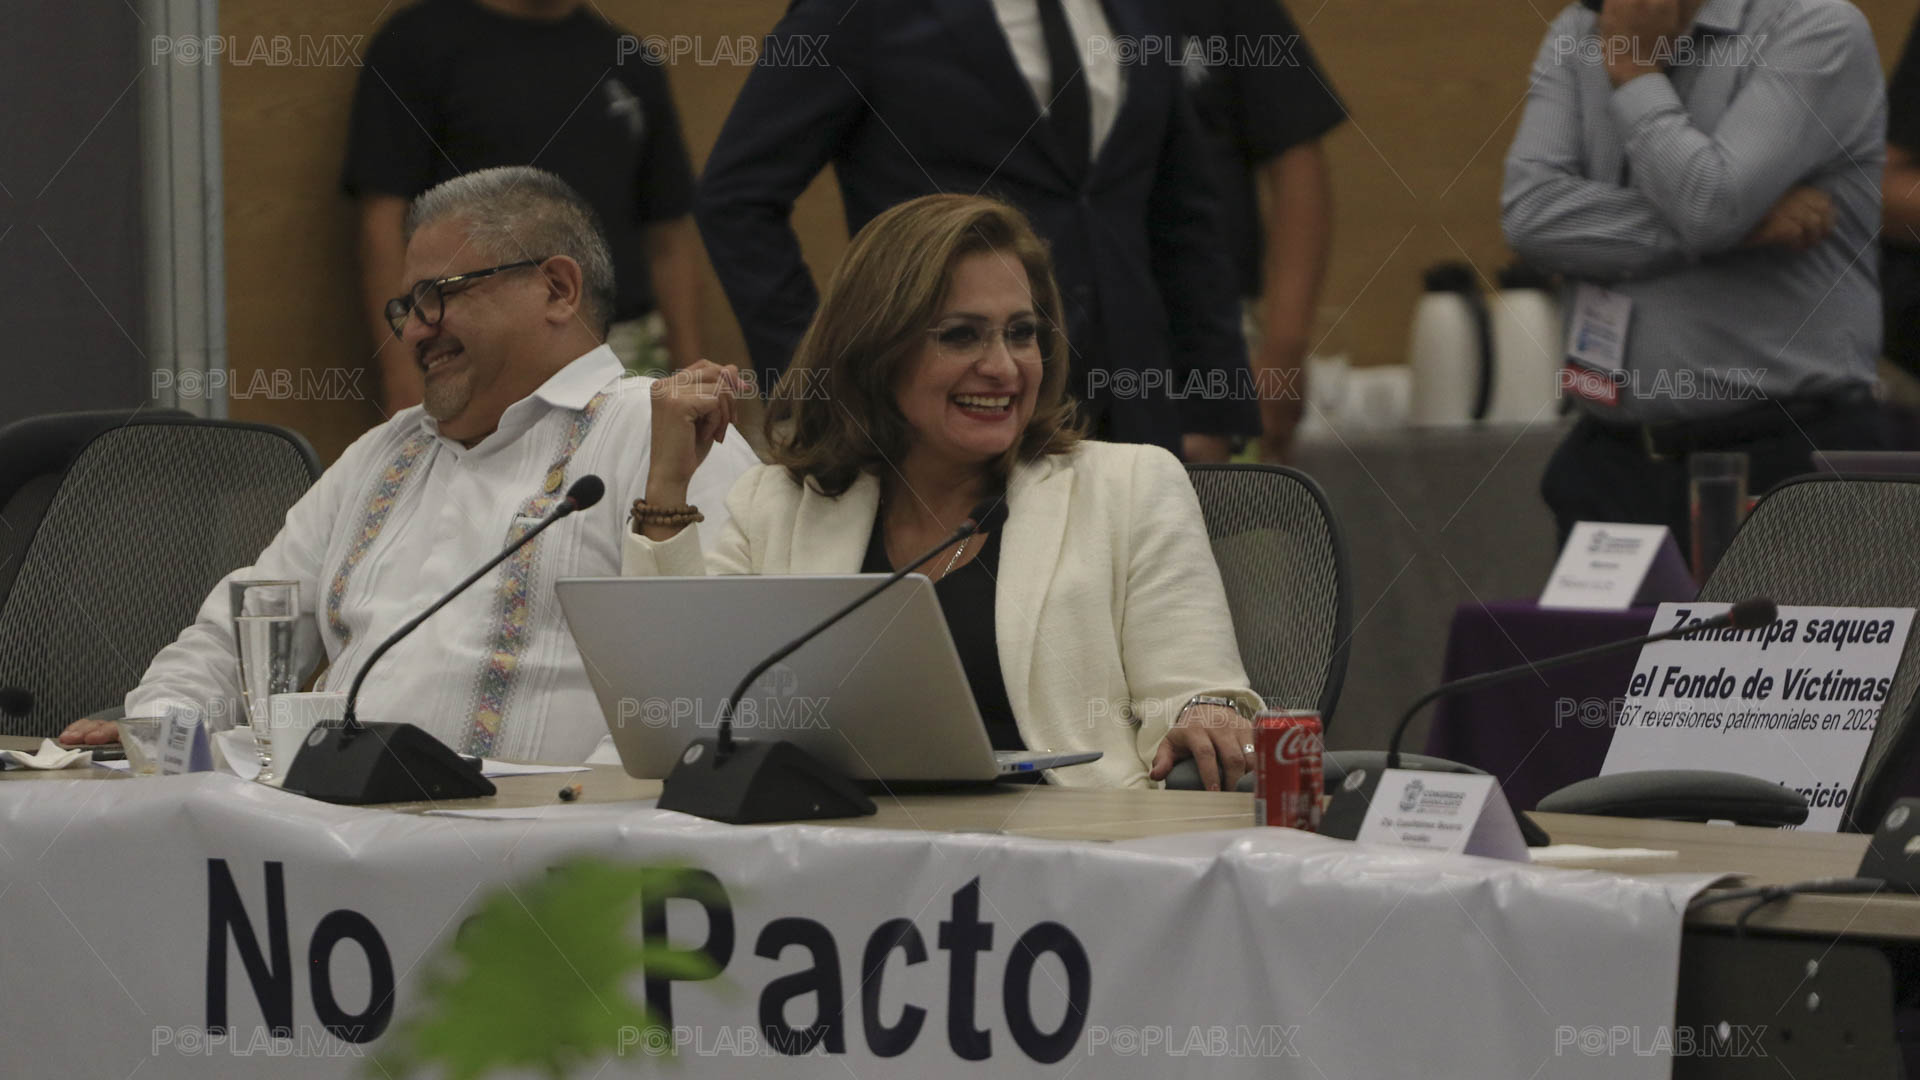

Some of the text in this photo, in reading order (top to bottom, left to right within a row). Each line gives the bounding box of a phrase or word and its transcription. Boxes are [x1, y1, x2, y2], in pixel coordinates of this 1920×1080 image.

[1802, 618, 1896, 651] saquea
[1628, 665, 1891, 702] el Fondo de Víctimas
[1640, 706, 1722, 729] reversiones
[1722, 707, 1819, 734] patrimoniales
[1821, 713, 1840, 730] en
[1842, 708, 1881, 731] 2023
[204, 858, 396, 1045] No
[641, 866, 1093, 1065] Pacto
